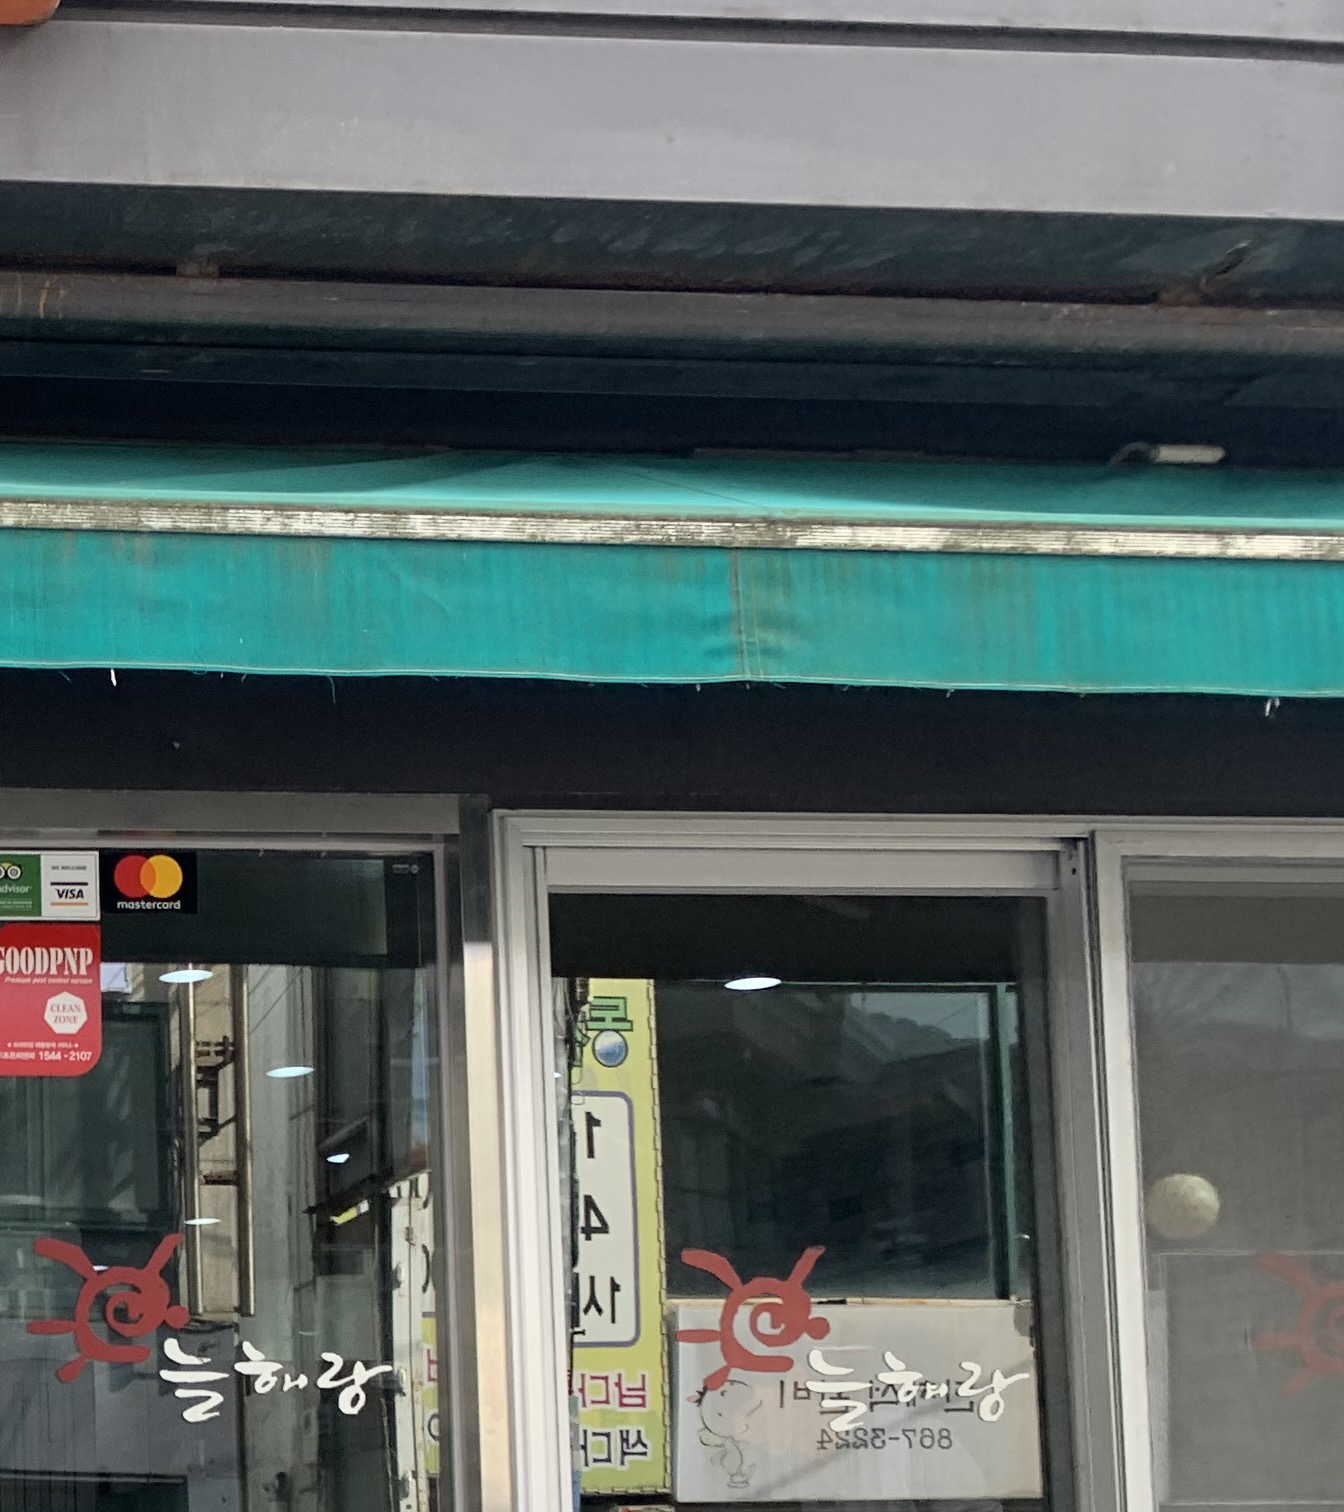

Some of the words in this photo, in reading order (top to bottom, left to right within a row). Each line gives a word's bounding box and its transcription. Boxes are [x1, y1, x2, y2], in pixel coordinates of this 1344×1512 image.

[56, 888, 84, 900] VISA
[117, 900, 181, 910] mastercard
[50, 1004, 81, 1013] CLEAN
[53, 1015, 78, 1024] ZONE
[158, 1337, 393, 1423] 늘해랑
[806, 1347, 1030, 1430] 늘해랑
